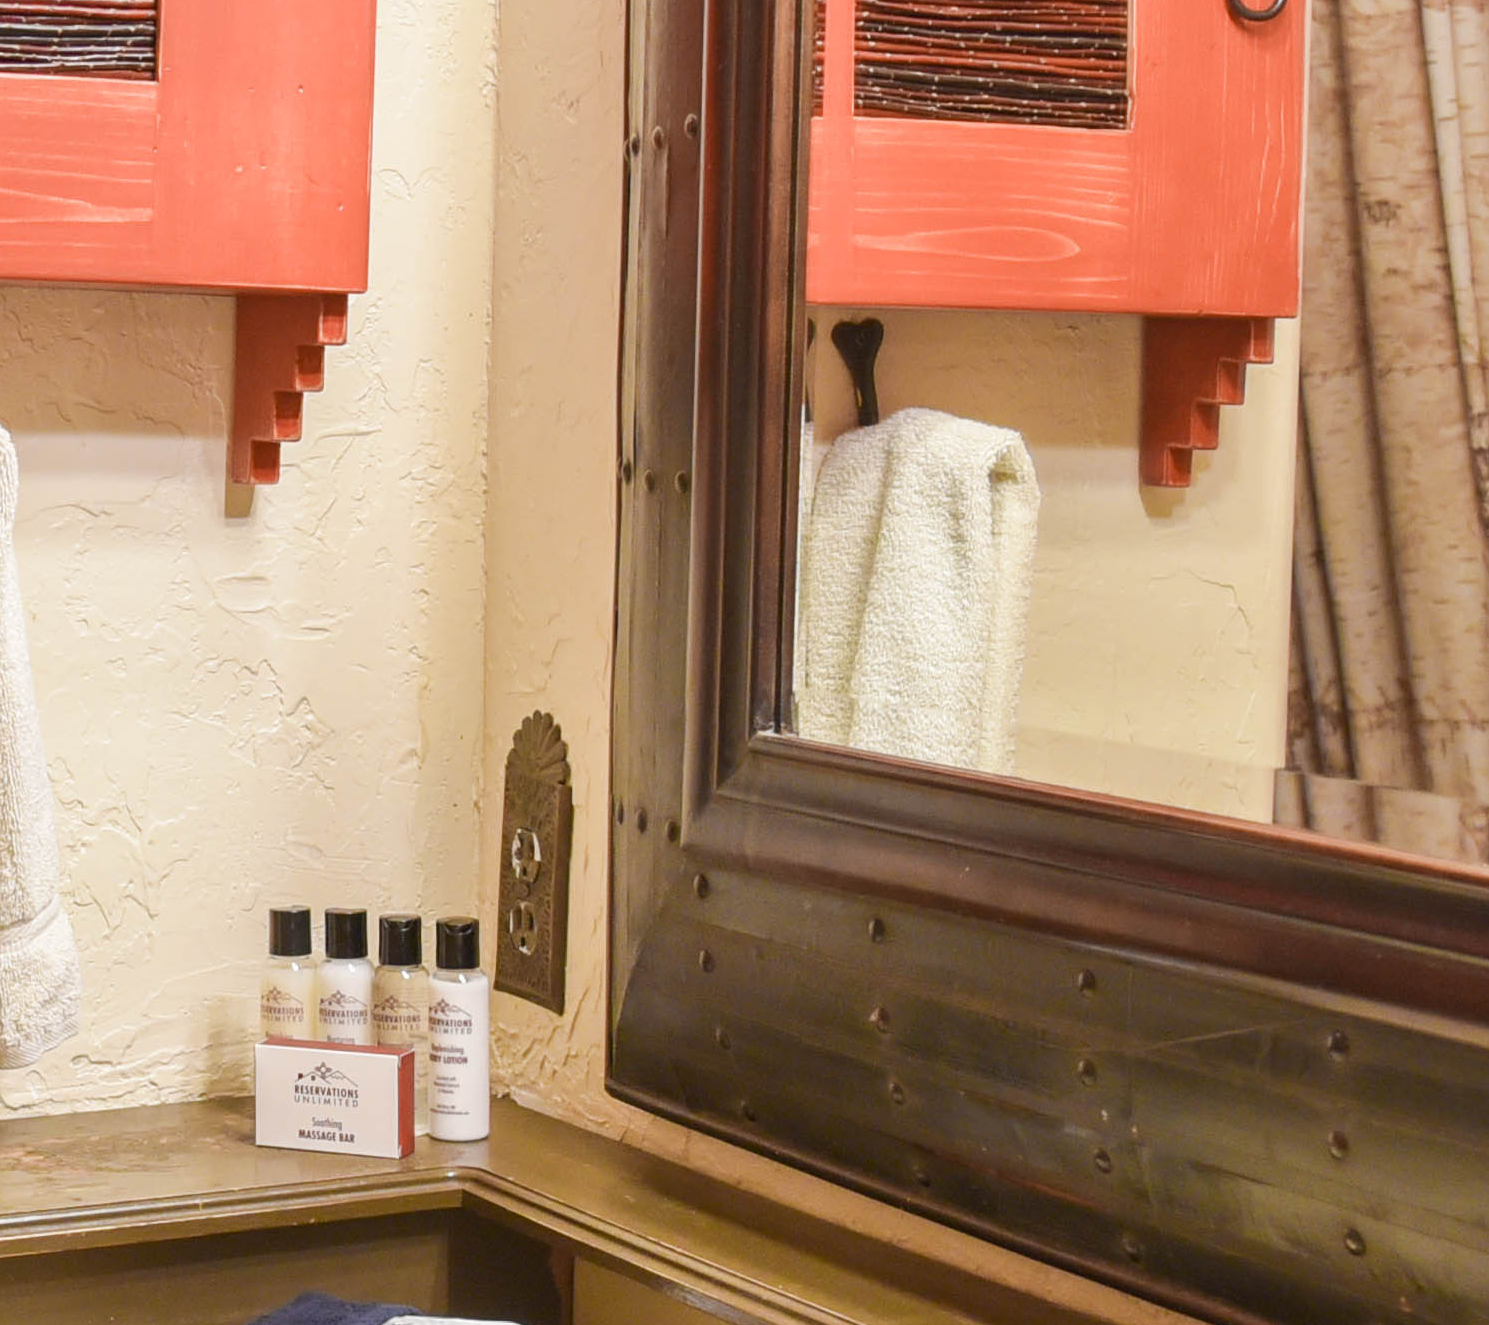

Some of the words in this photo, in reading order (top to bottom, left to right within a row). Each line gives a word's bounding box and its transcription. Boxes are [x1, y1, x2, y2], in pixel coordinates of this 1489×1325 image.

[443, 1056, 468, 1064] LOTION
[294, 1085, 359, 1099] RESERVATIONS
[294, 1095, 359, 1107] UNLIMITED
[312, 1117, 342, 1131] Soothing
[298, 1129, 336, 1142] MASSAGE
[339, 1133, 355, 1143] BAR
